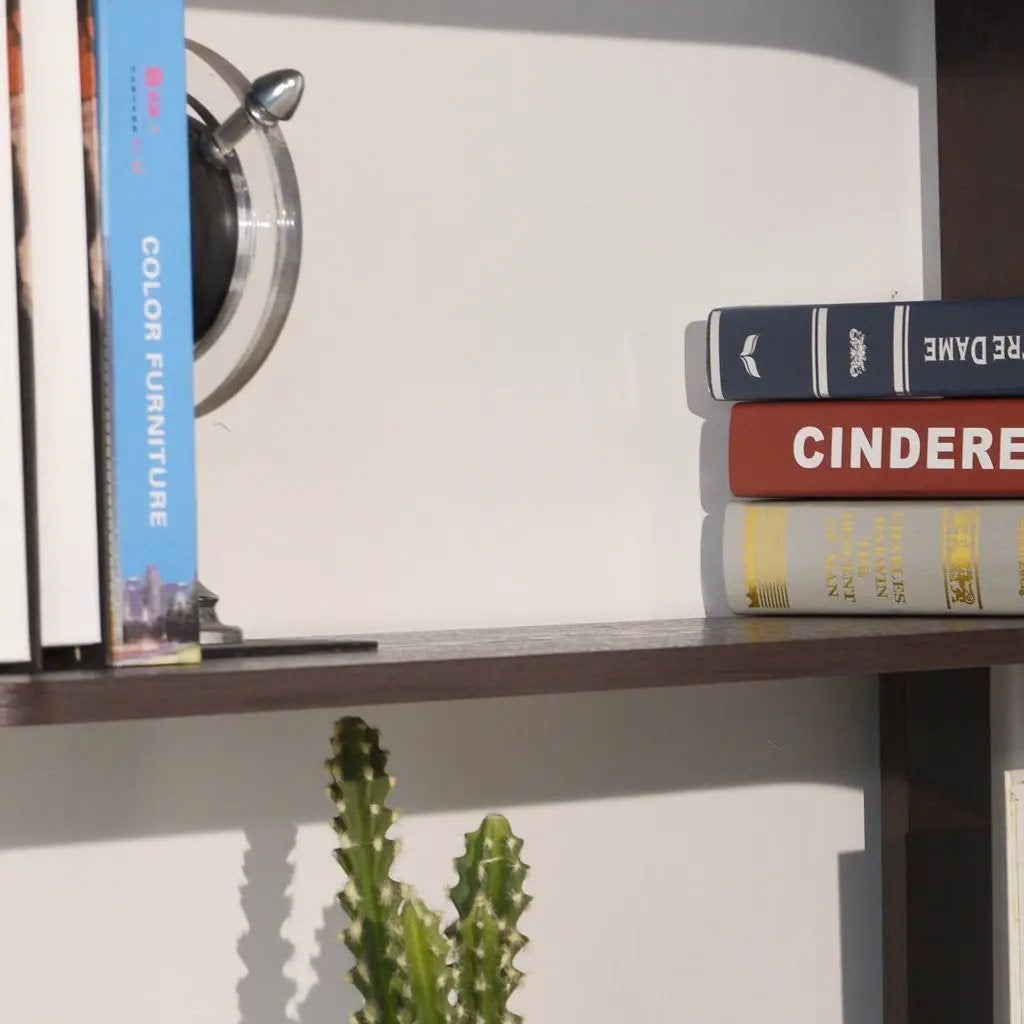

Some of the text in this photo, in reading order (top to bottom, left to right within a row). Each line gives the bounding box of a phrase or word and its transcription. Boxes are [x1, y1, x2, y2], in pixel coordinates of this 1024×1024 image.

[142, 236, 168, 527] COLOR FURNITURE
[924, 336, 987, 366] DAME
